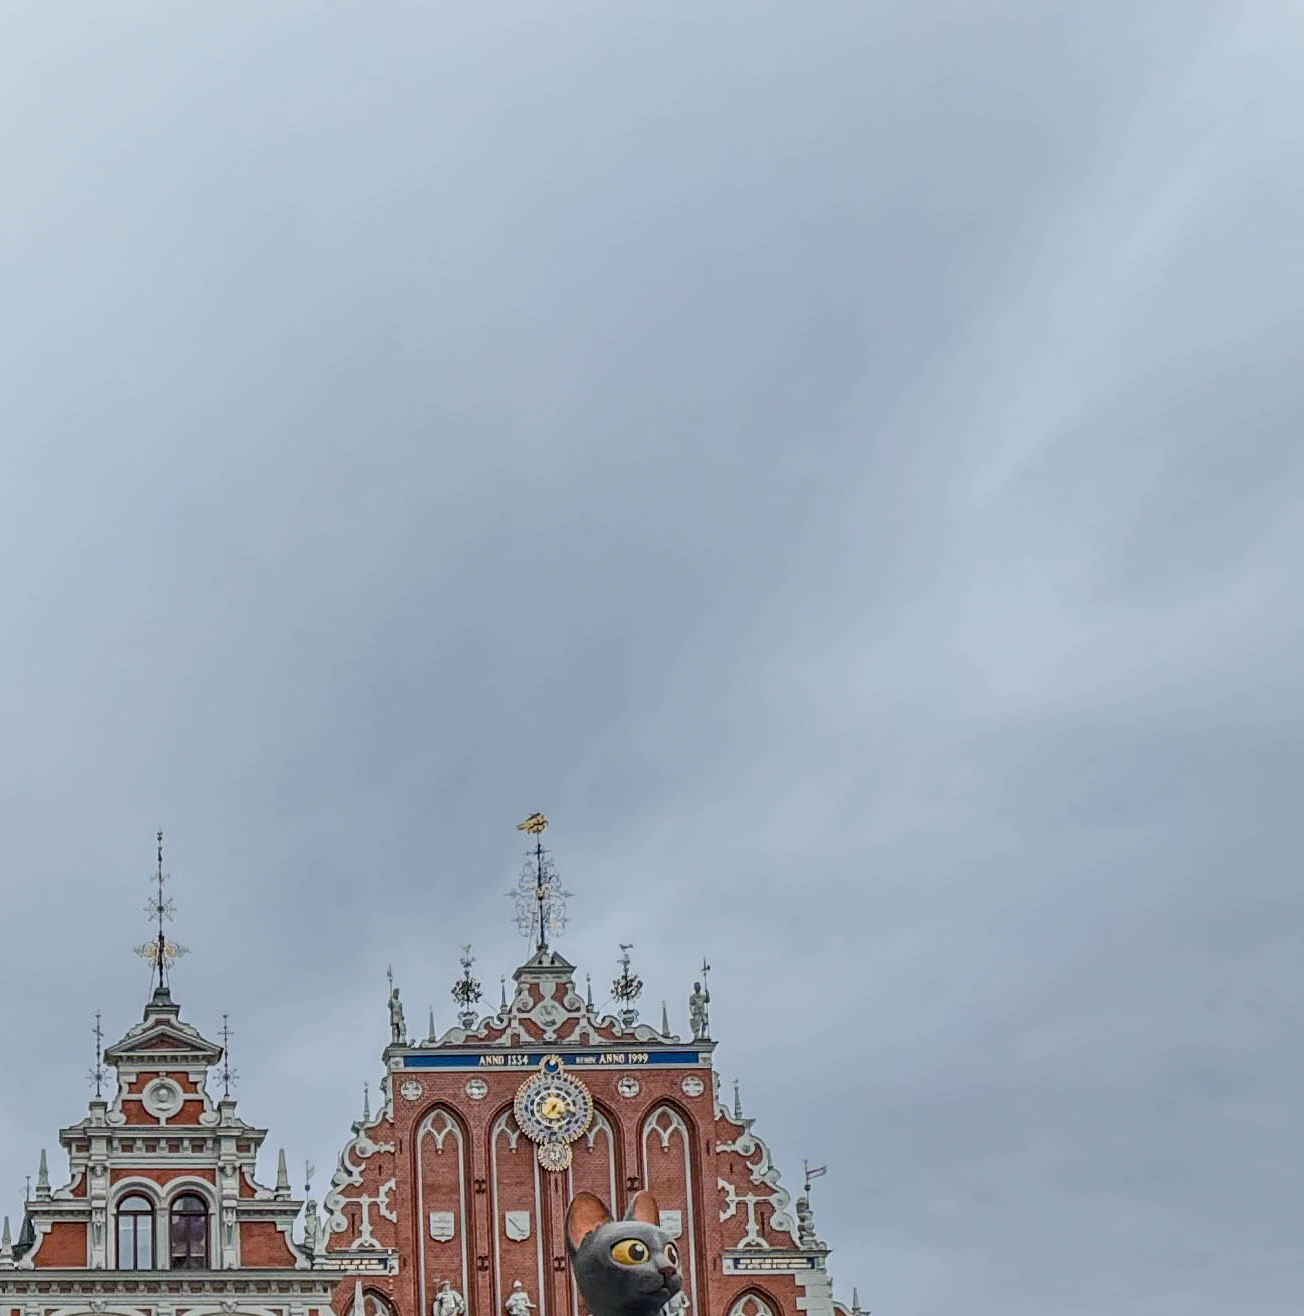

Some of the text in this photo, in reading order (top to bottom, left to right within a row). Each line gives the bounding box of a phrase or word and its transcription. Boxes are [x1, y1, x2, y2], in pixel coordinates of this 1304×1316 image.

[478, 1054, 505, 1066] ANNO
[598, 1053, 625, 1065] ANNO
[628, 1053, 649, 1065] 1999
